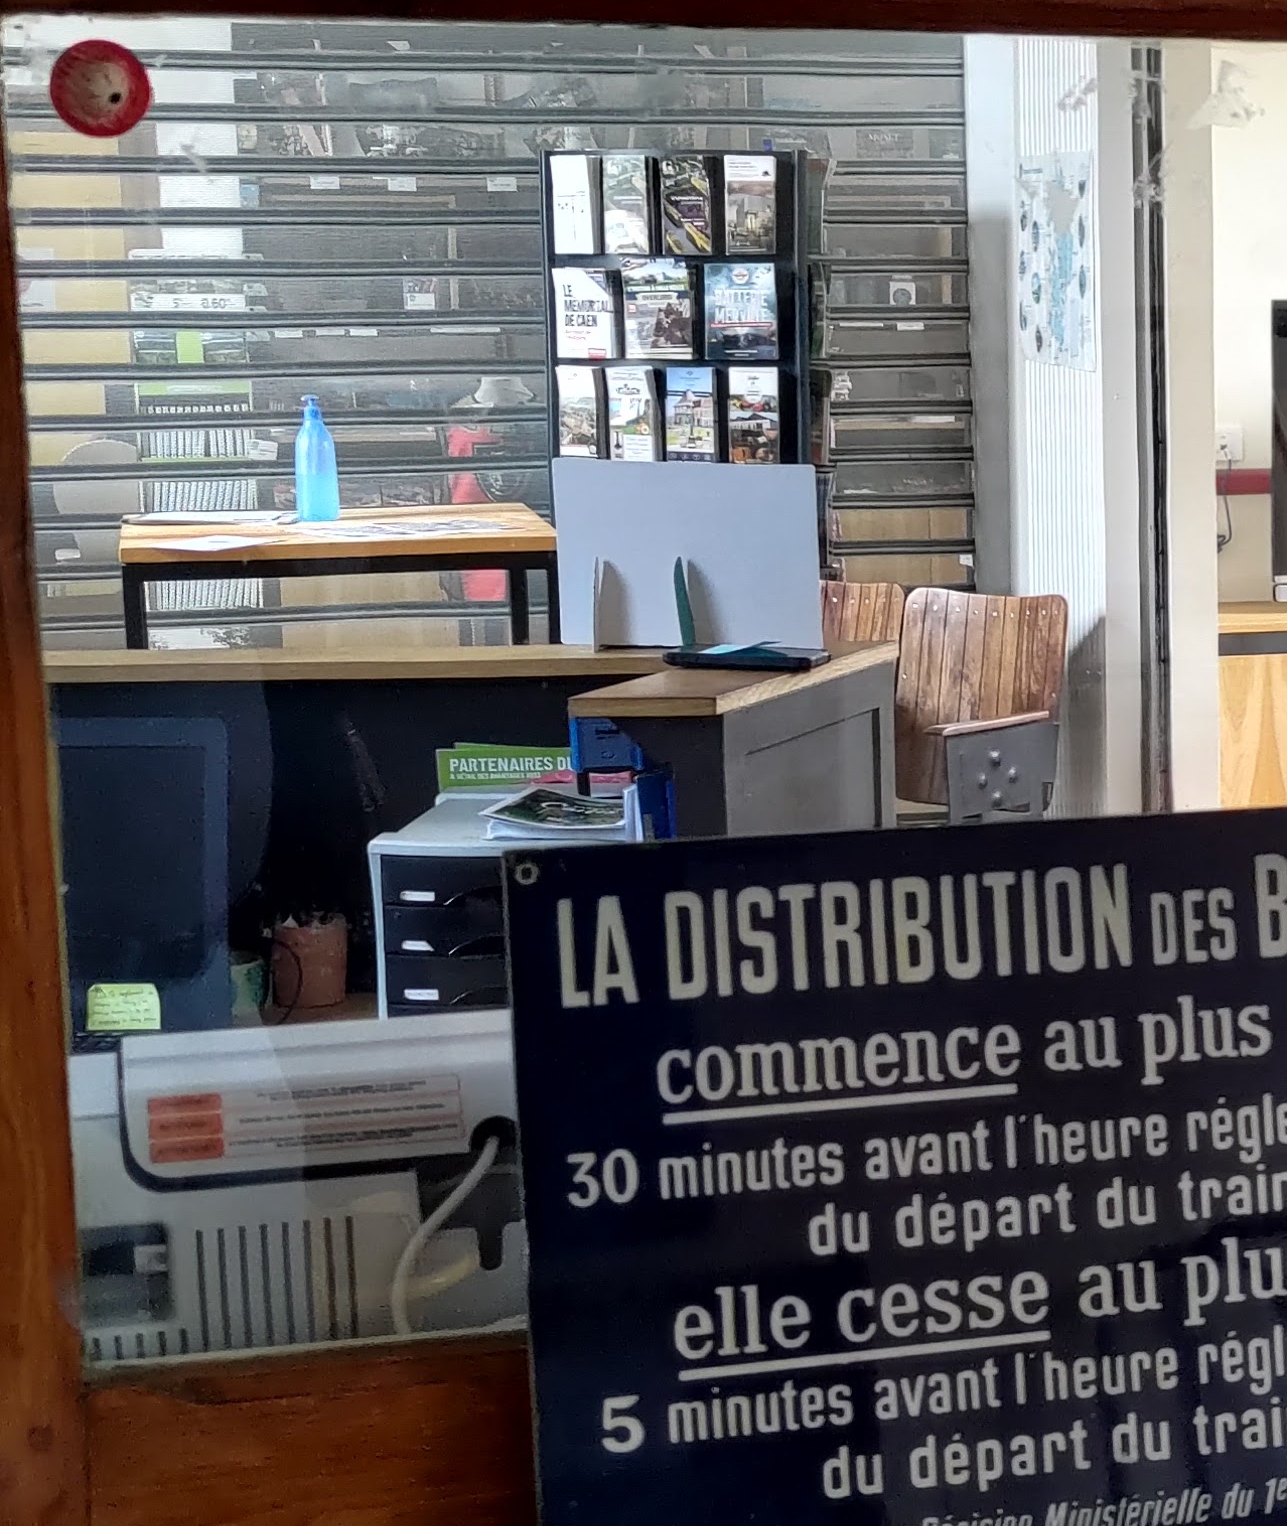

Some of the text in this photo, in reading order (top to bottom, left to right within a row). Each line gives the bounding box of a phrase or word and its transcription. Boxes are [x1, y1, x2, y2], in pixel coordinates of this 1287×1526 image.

[449, 756, 554, 772] PARTENAIRES
[557, 896, 638, 1008] LA
[665, 865, 1132, 1001] DISTRIBUTION
[1152, 889, 1237, 967] DES
[657, 1024, 1020, 1104] commence
[1044, 1017, 1122, 1071] au
[1139, 996, 1271, 1085] plus
[568, 1149, 639, 1207] 30
[659, 1135, 844, 1199] minutes
[865, 1117, 992, 1180] avant
[1005, 1111, 1167, 1168] l'heure
[809, 1203, 869, 1256] du
[895, 1183, 1076, 1253] départ
[1097, 1176, 1156, 1229] du
[674, 1285, 810, 1359] elle
[838, 1271, 1048, 1342] cesse
[1079, 1261, 1161, 1317] au
[602, 1395, 644, 1453] 5
[668, 1374, 852, 1444] minutes
[874, 1359, 1000, 1421] avant
[1015, 1348, 1178, 1405] l'heure
[823, 1445, 883, 1499] du
[909, 1420, 1090, 1493] départ
[1112, 1419, 1172, 1466] du
[1222, 1483, 1254, 1520] du
